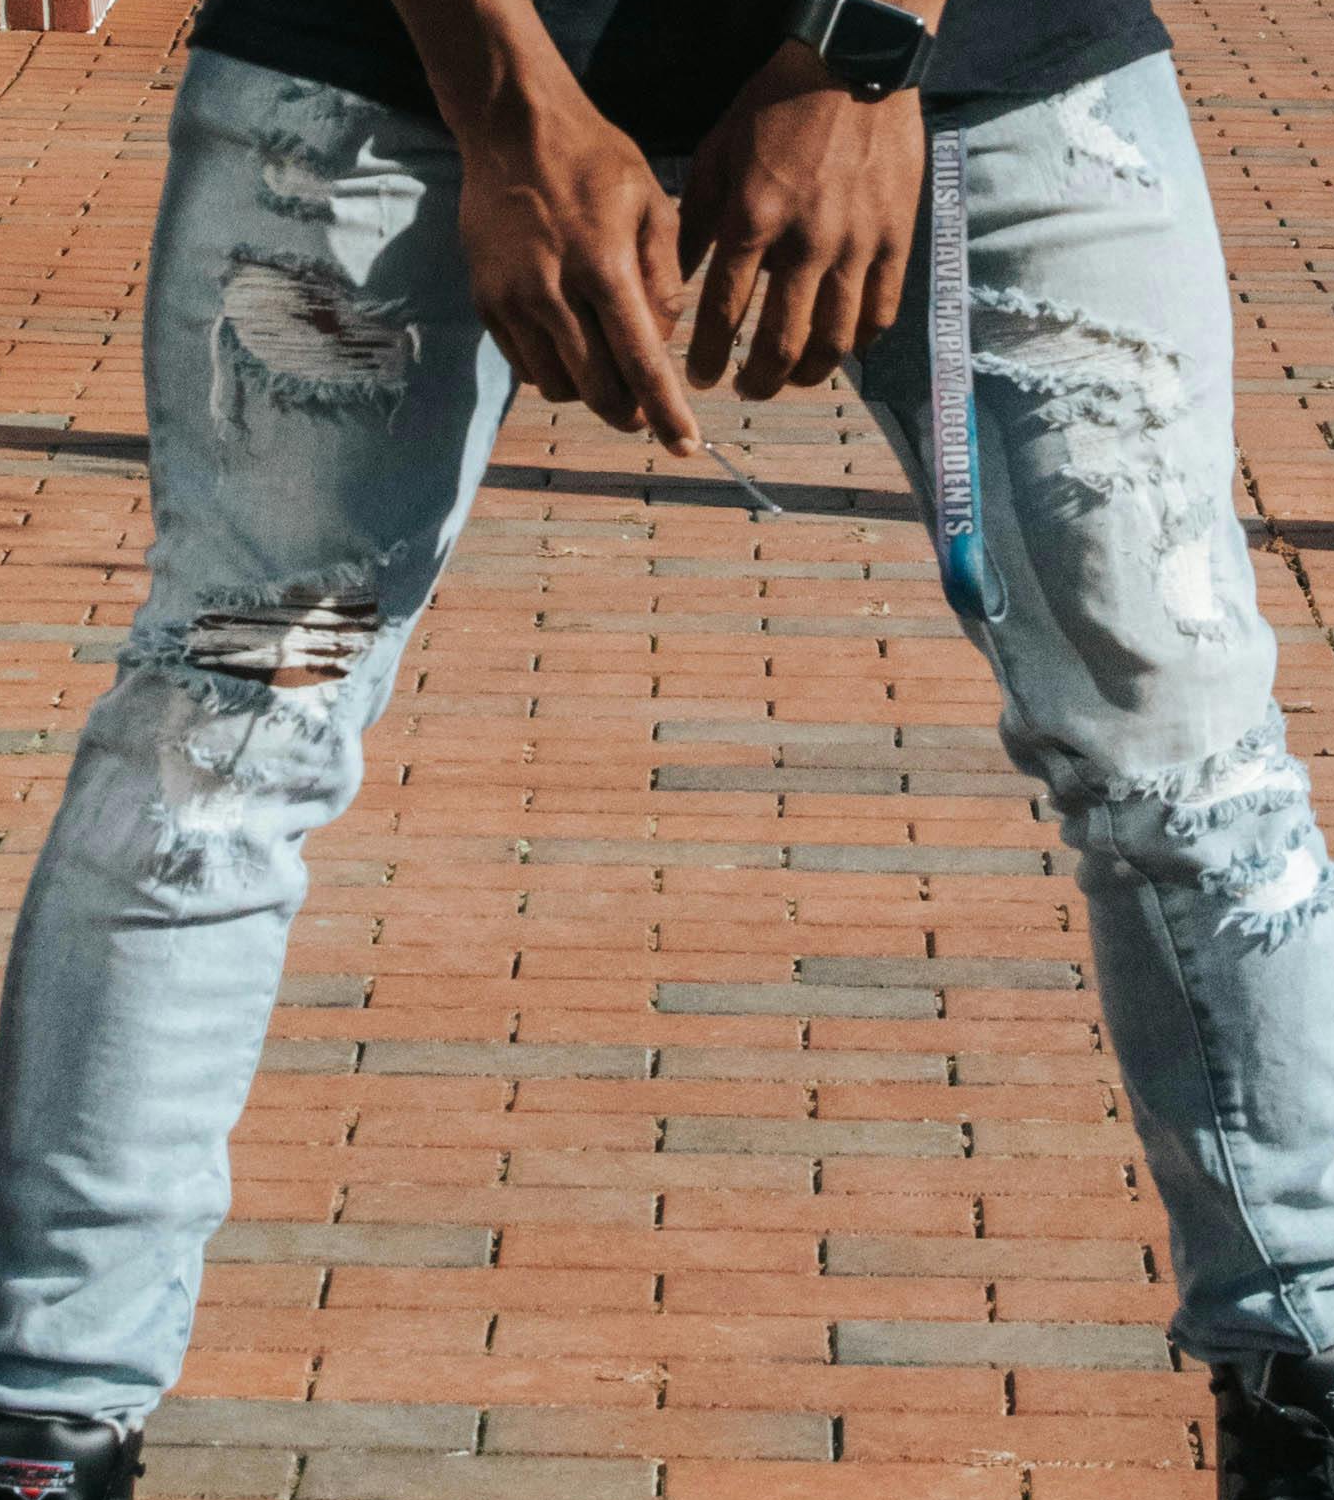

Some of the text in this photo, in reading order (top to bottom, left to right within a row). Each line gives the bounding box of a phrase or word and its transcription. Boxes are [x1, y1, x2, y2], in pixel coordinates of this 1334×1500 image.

[934, 154, 962, 221] JUST
[935, 227, 961, 293] HAVE
[936, 299, 966, 384] HAPPY
